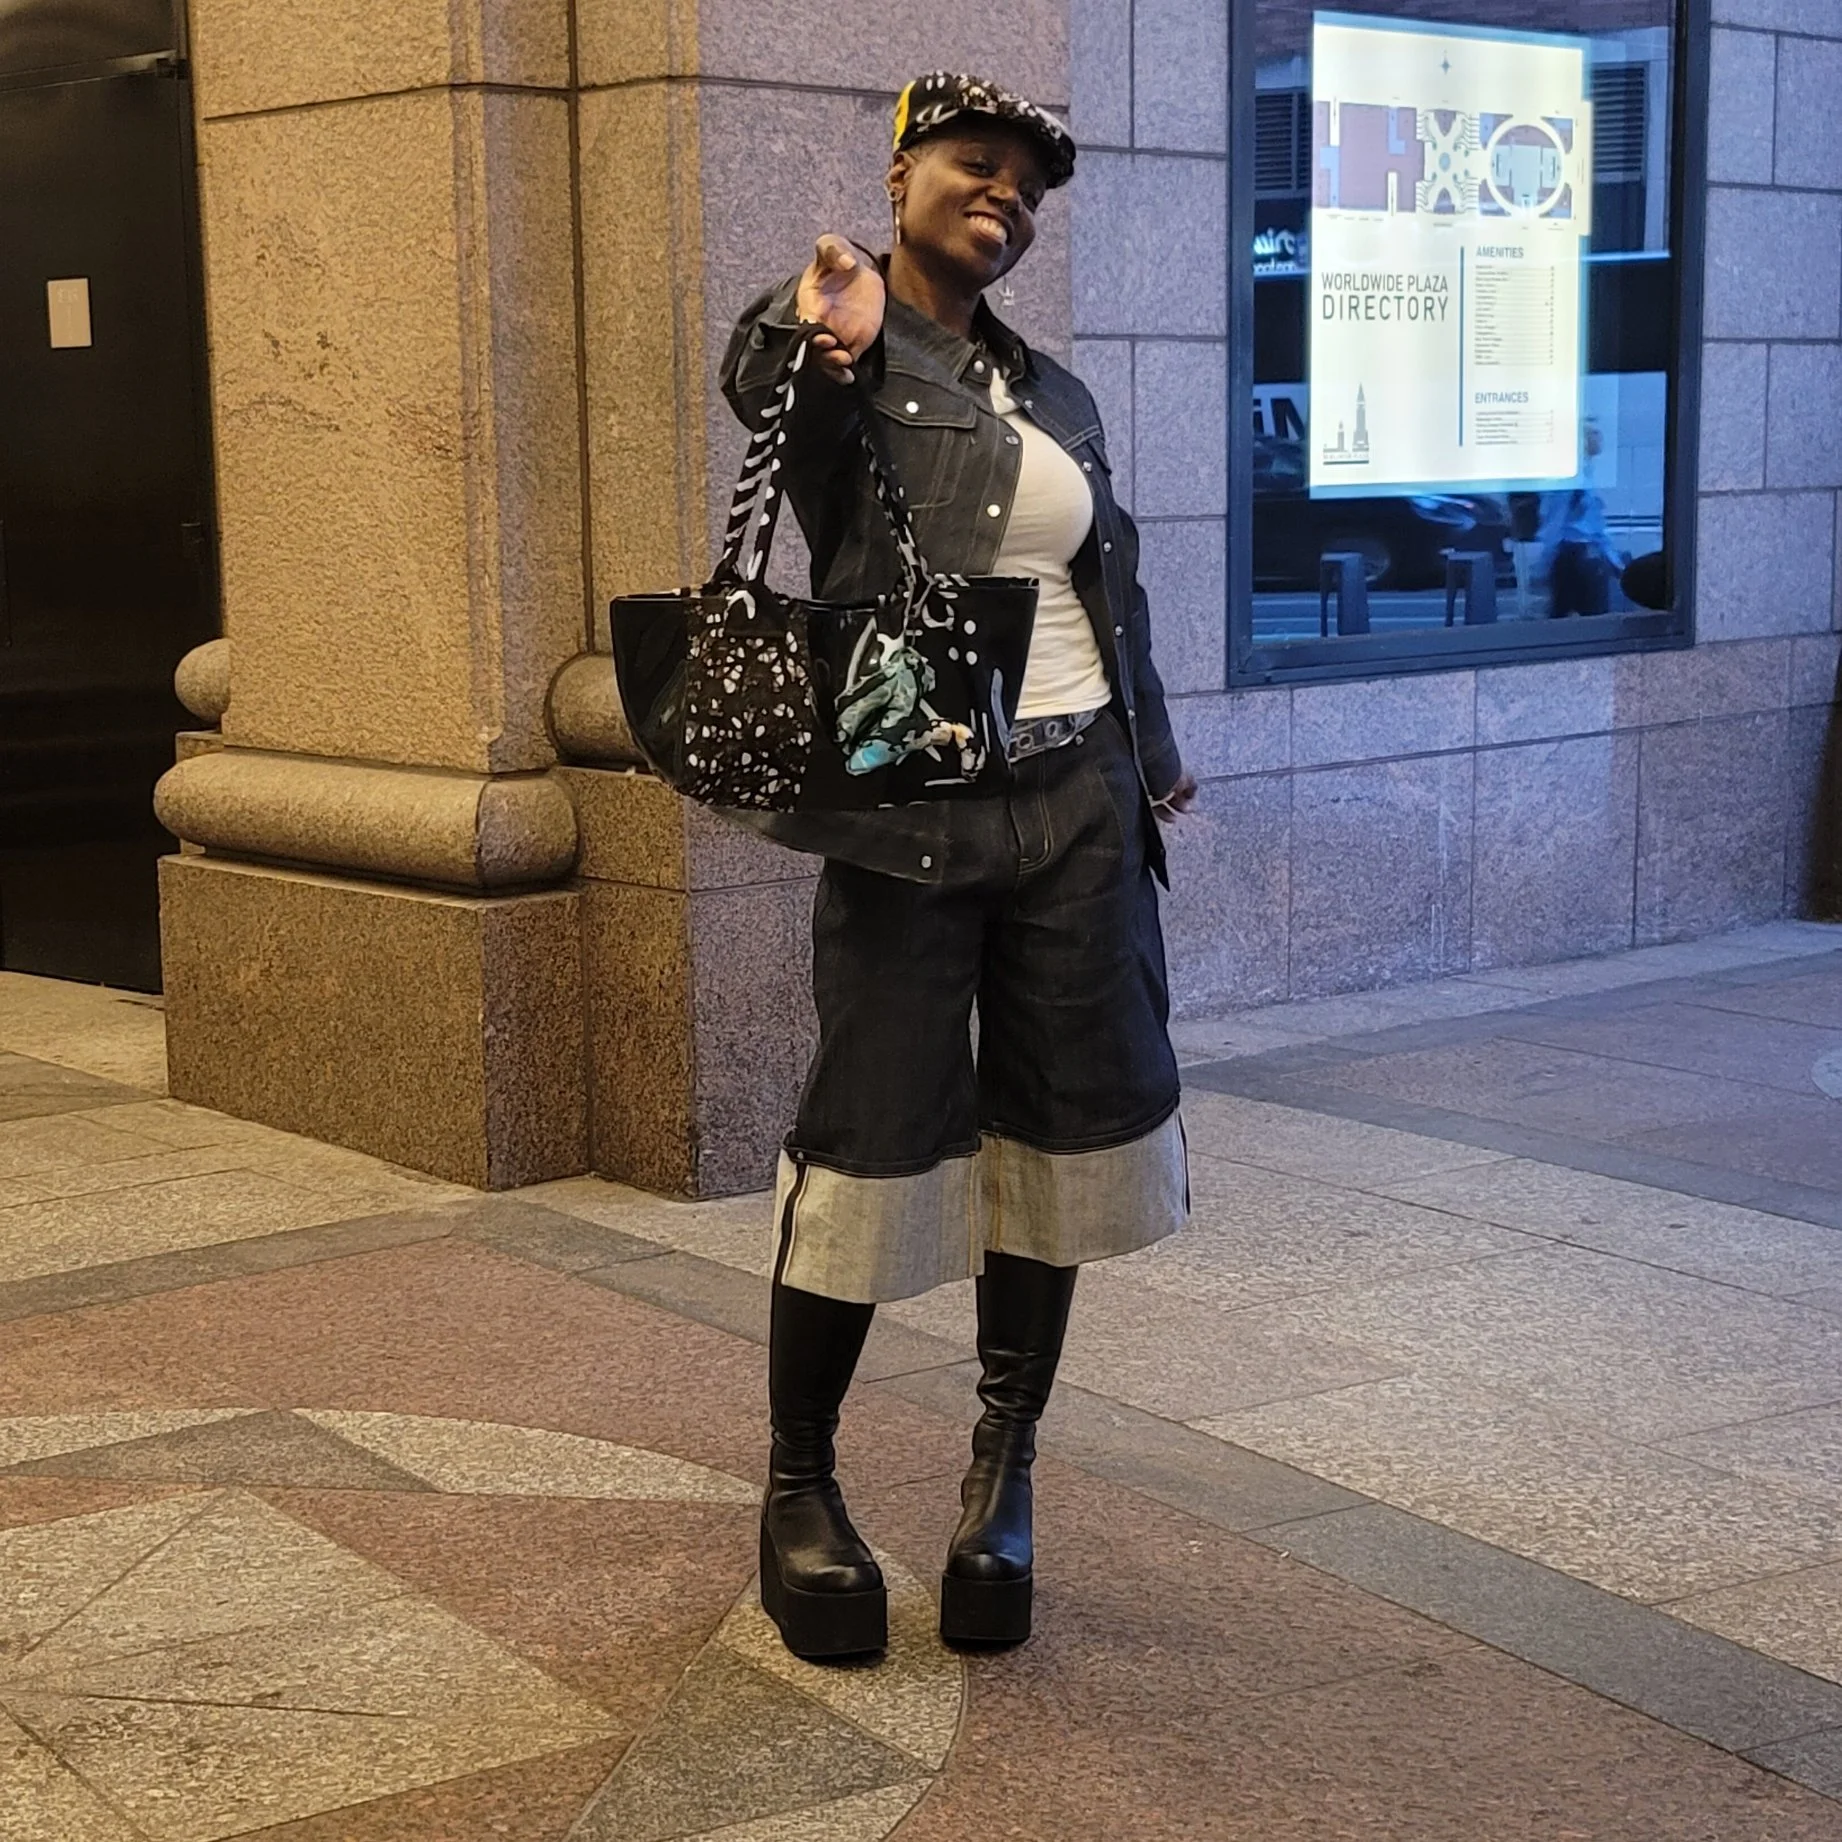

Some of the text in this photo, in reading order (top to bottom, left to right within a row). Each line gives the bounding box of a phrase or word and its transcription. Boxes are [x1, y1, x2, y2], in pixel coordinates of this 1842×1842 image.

[1475, 246, 1524, 258] AMENITIES
[1322, 272, 1448, 292] WORLDWIDE PLAZA
[1322, 294, 1448, 321] DIRECTORY
[1475, 391, 1529, 404] ENTRANCES
